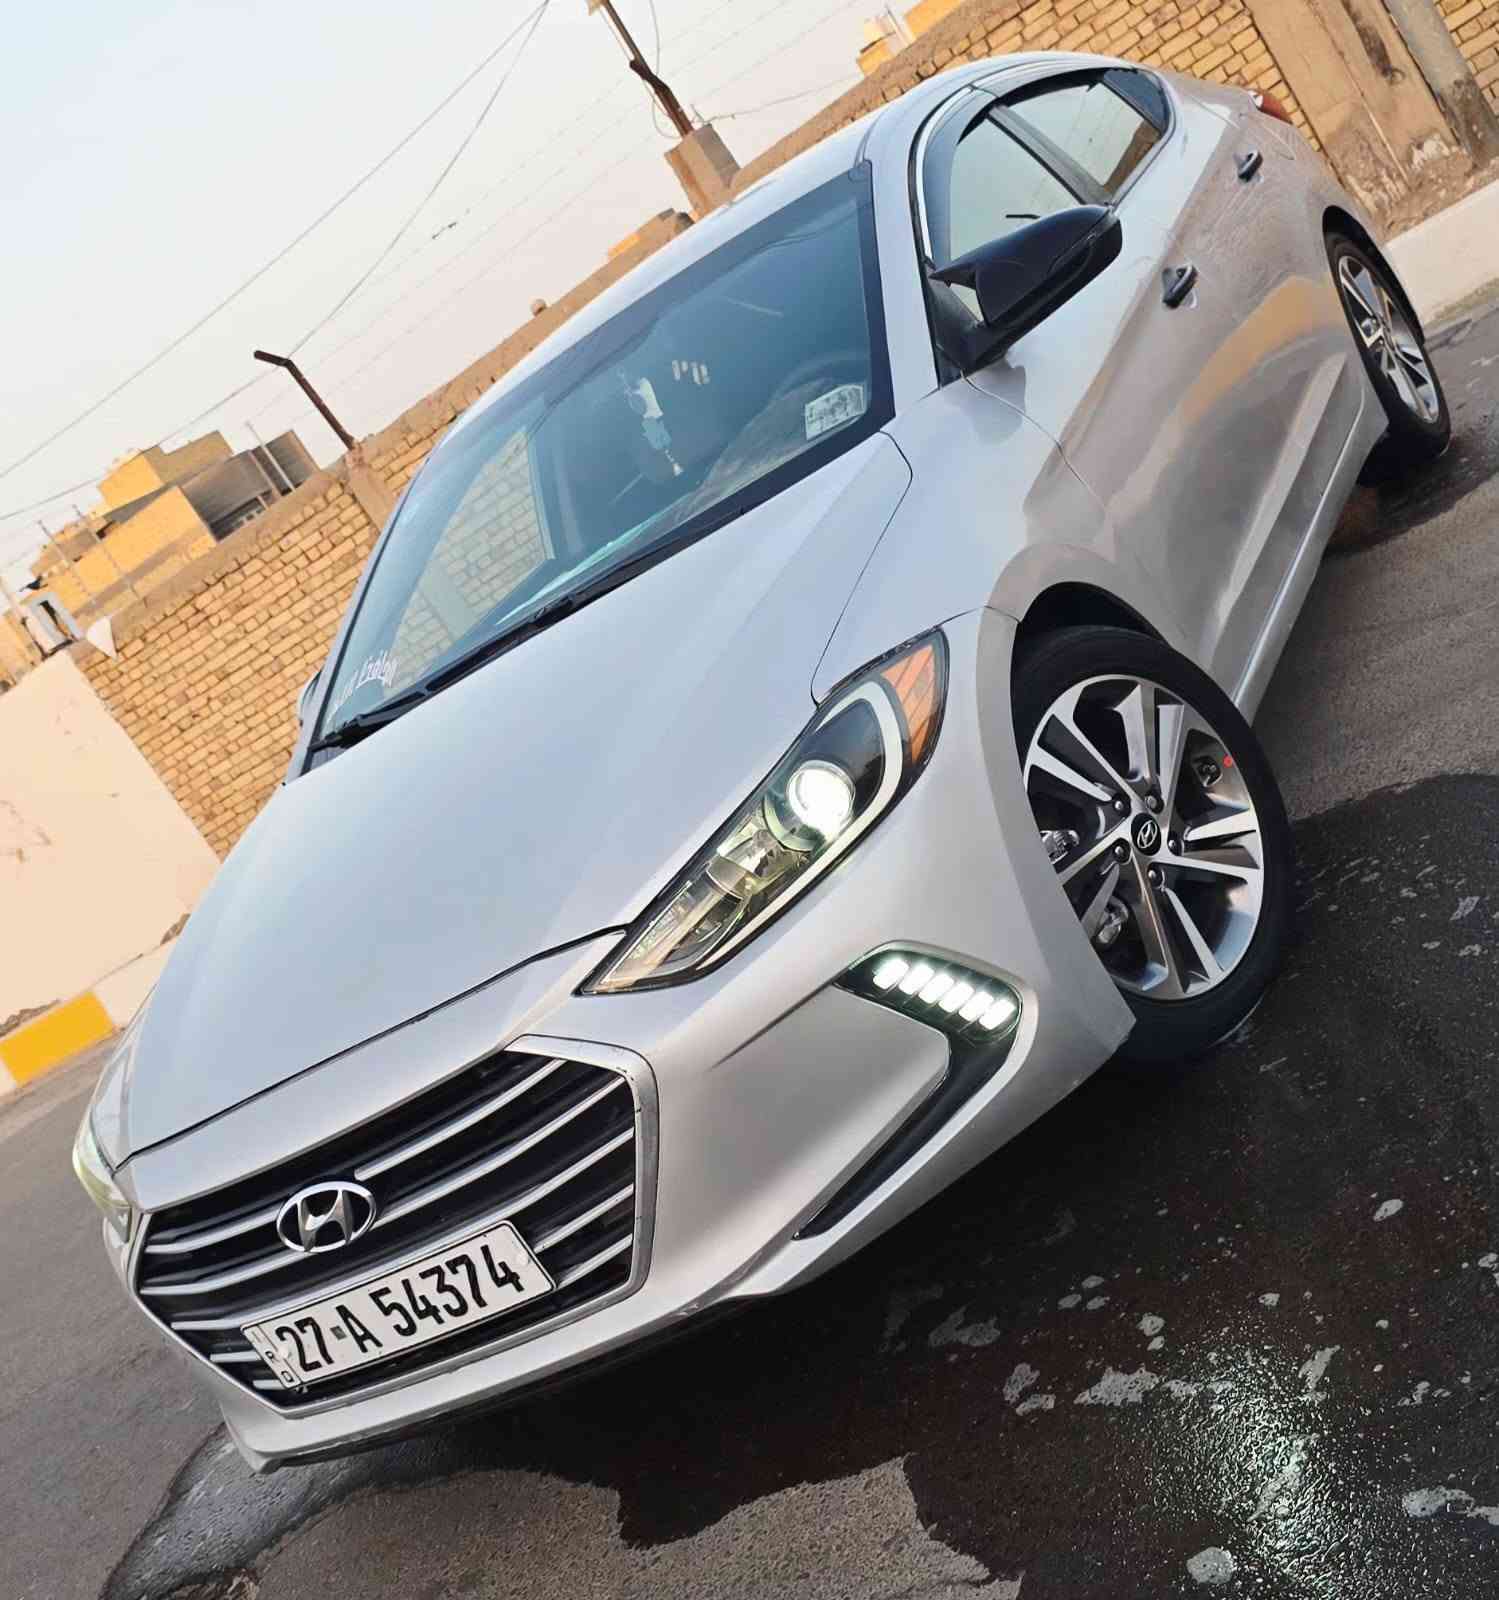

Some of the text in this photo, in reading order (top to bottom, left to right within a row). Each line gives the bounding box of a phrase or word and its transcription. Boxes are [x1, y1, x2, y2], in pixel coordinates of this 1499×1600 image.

[275, 1245, 525, 1372] 27 A 54374
